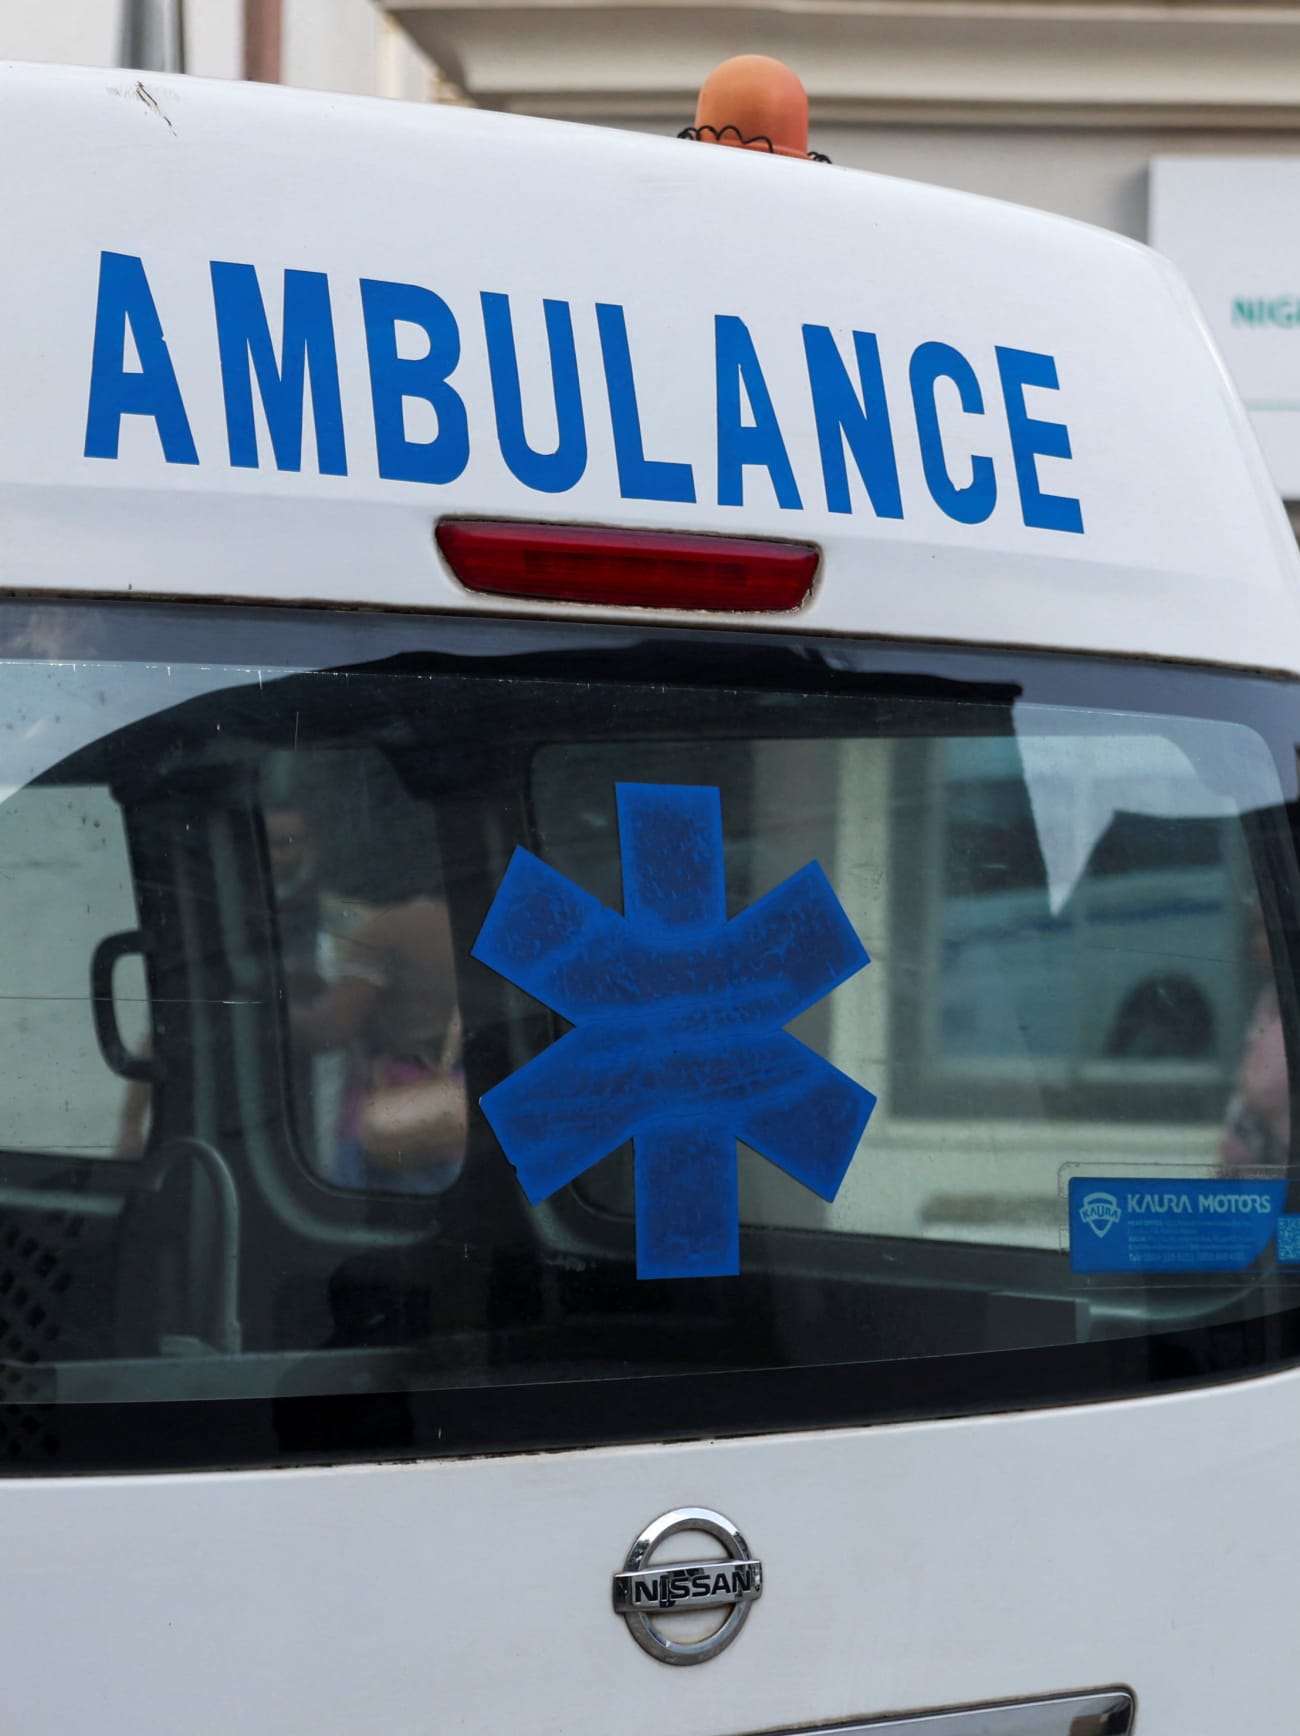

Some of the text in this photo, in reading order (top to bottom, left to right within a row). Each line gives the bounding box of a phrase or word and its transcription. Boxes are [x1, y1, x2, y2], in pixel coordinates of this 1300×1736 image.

[84, 251, 1085, 534] AMBULANCE
[1083, 1205, 1120, 1221] KAURA
[1128, 1194, 1272, 1214] KAURA MOTORS
[634, 1572, 751, 1604] NISSAN
